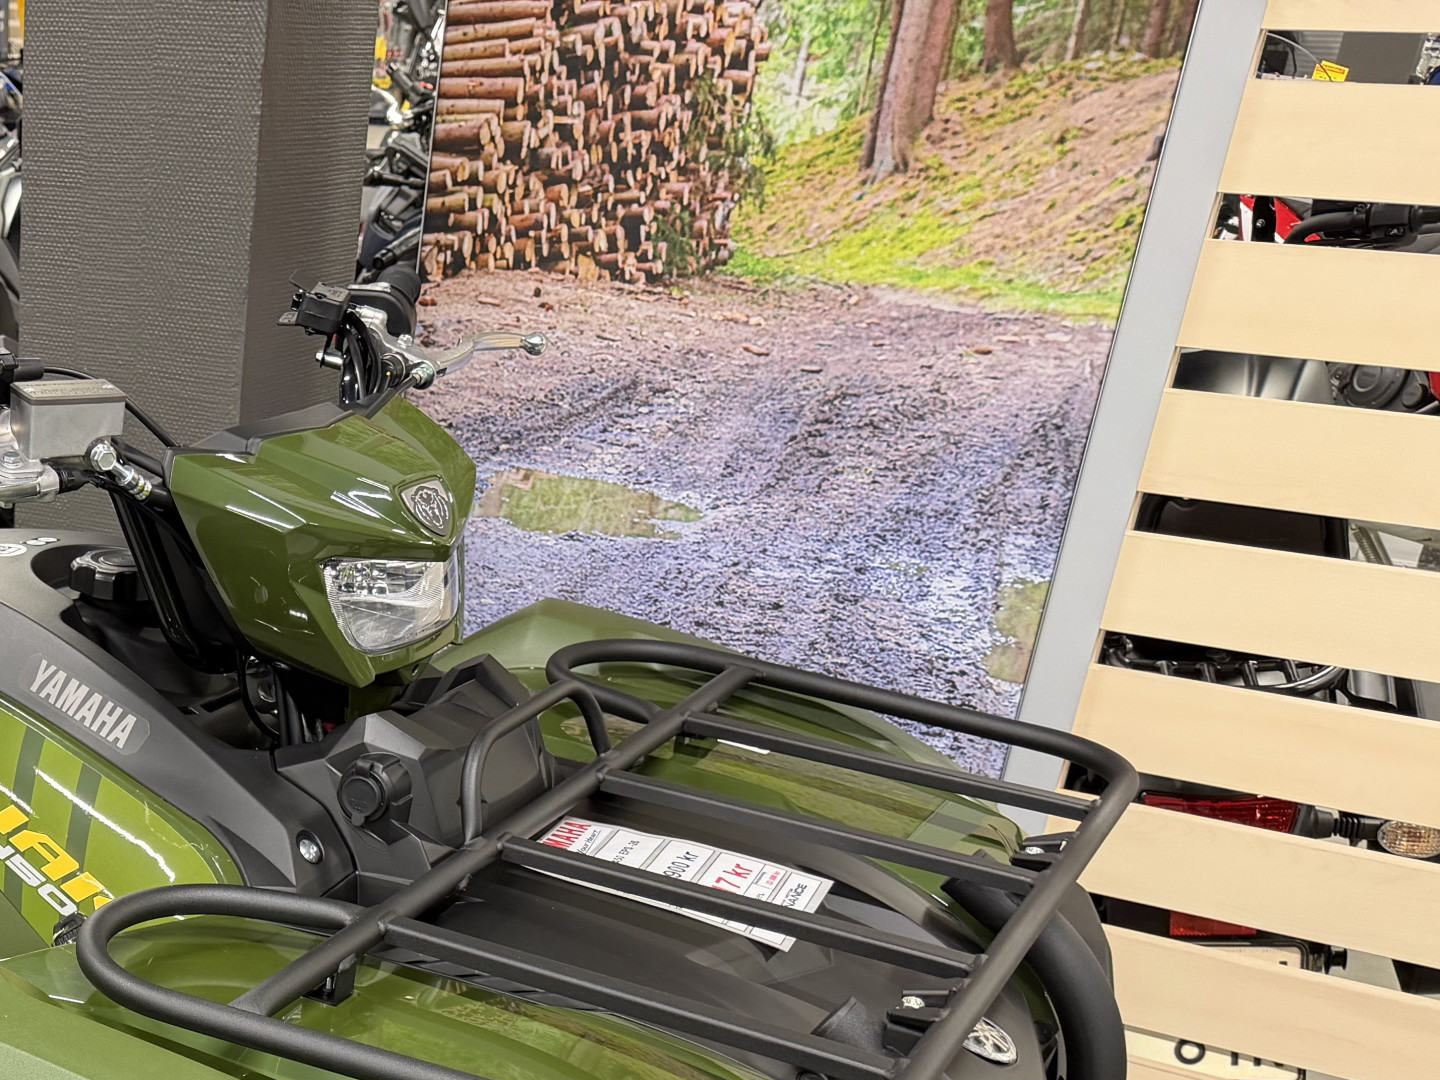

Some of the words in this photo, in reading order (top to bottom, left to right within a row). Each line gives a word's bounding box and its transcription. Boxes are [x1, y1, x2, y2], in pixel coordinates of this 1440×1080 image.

[29, 658, 138, 751] YAMAHA
[676, 851, 699, 863] kr
[722, 863, 753, 879] kr
